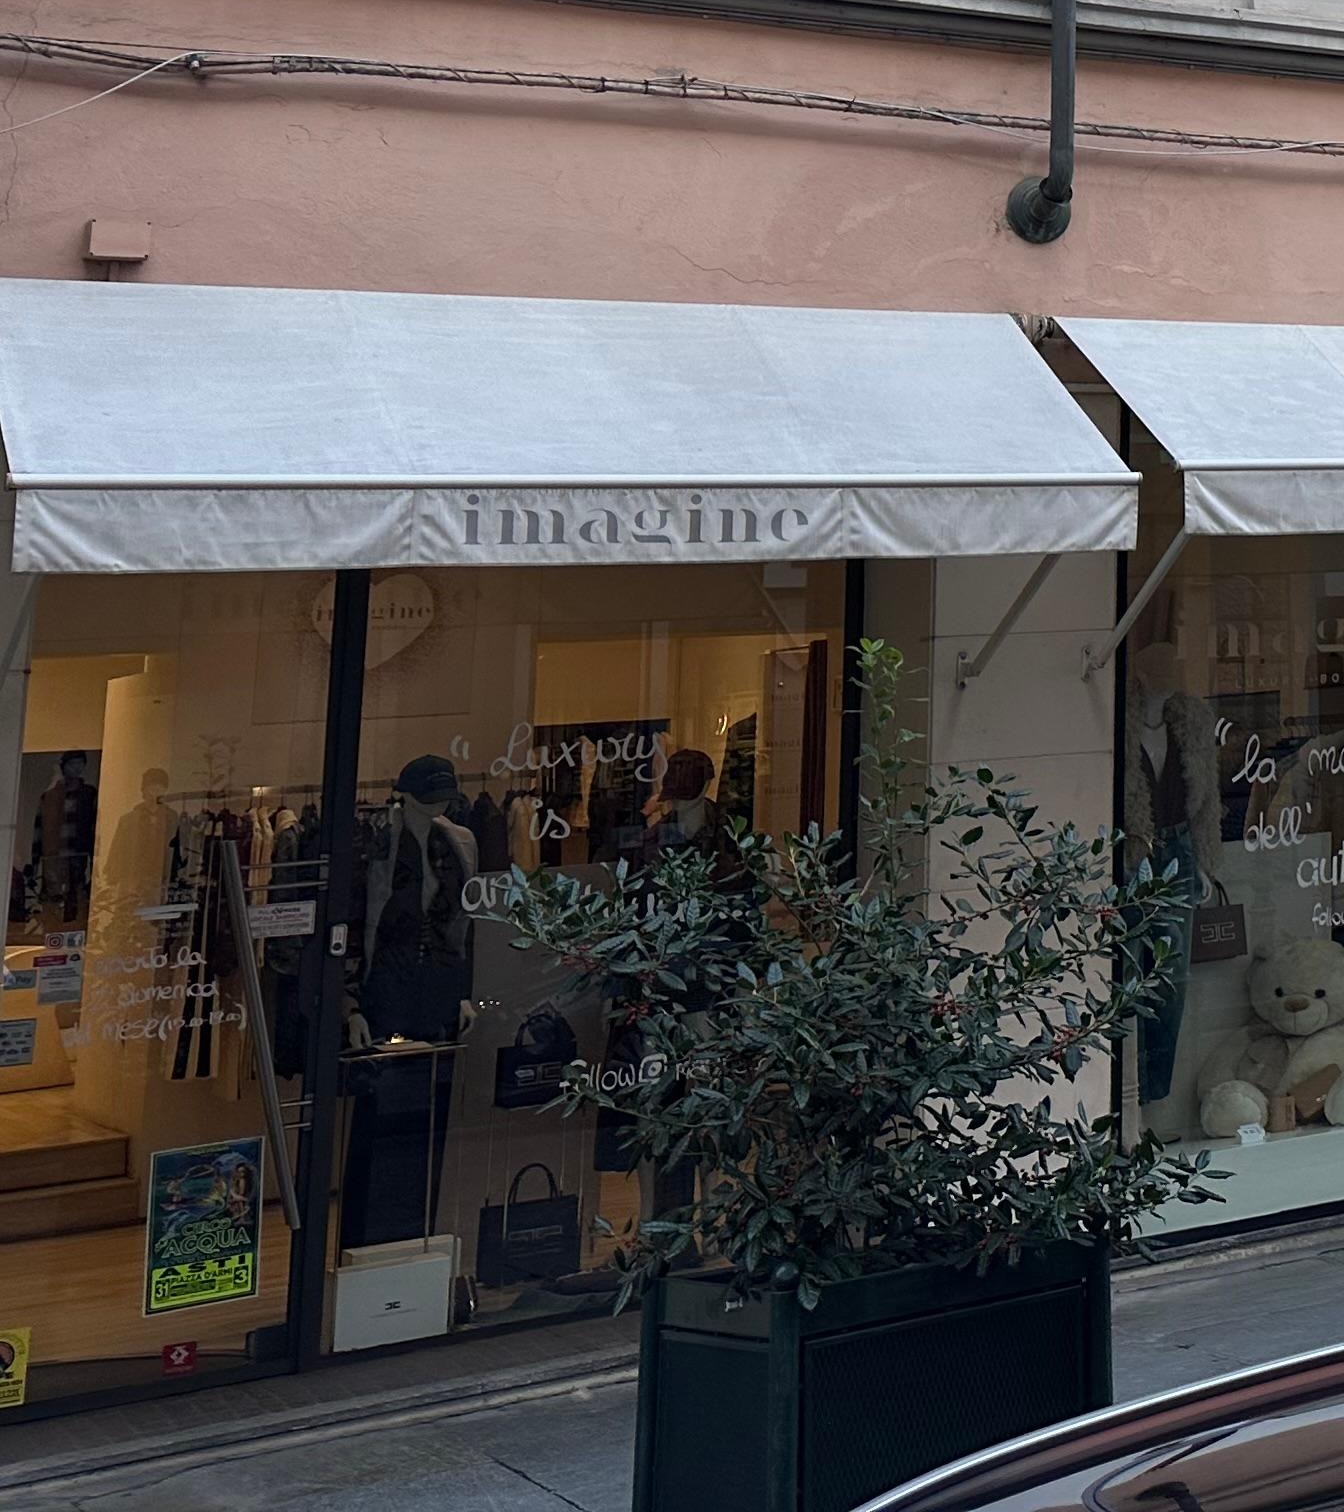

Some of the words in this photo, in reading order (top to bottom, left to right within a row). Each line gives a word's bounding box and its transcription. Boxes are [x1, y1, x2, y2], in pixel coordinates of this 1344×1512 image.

[461, 493, 809, 546] imagine
[316, 602, 431, 622] igine
[529, 800, 571, 840] is
[181, 1218, 233, 1236] CIRCO
[158, 1254, 247, 1279] ASTI
